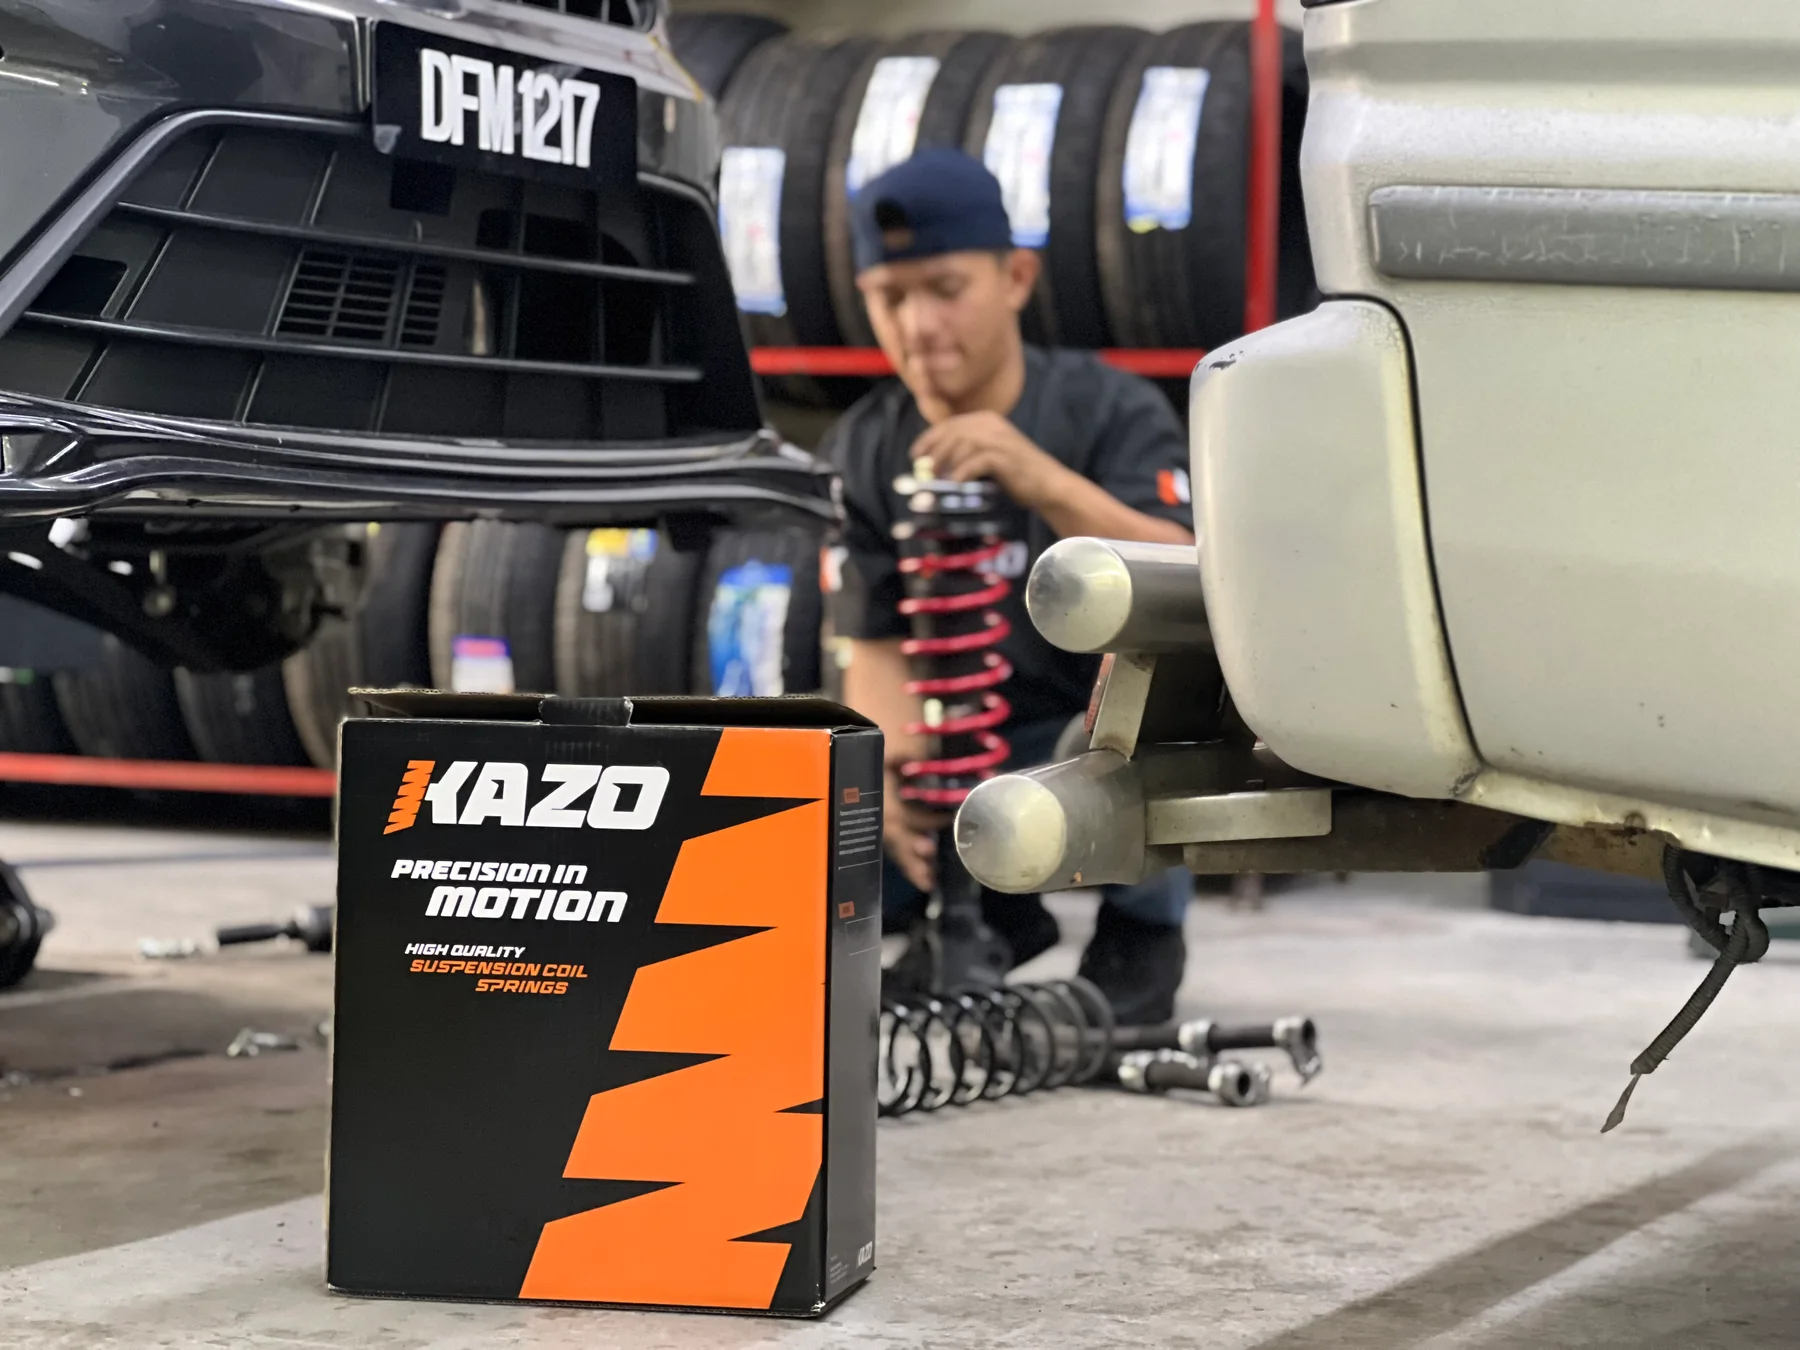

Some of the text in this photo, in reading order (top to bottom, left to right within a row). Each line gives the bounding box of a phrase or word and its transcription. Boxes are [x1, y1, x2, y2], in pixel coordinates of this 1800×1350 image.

[421, 48, 600, 168] DFM 1217
[383, 760, 670, 835] KAZO
[391, 859, 588, 884] PRECISION IN
[425, 886, 628, 923] MOTION
[405, 943, 526, 958] HIGH QUALITY
[410, 959, 588, 978] SUSPENSION COIL
[475, 978, 568, 995] SPRINGS
